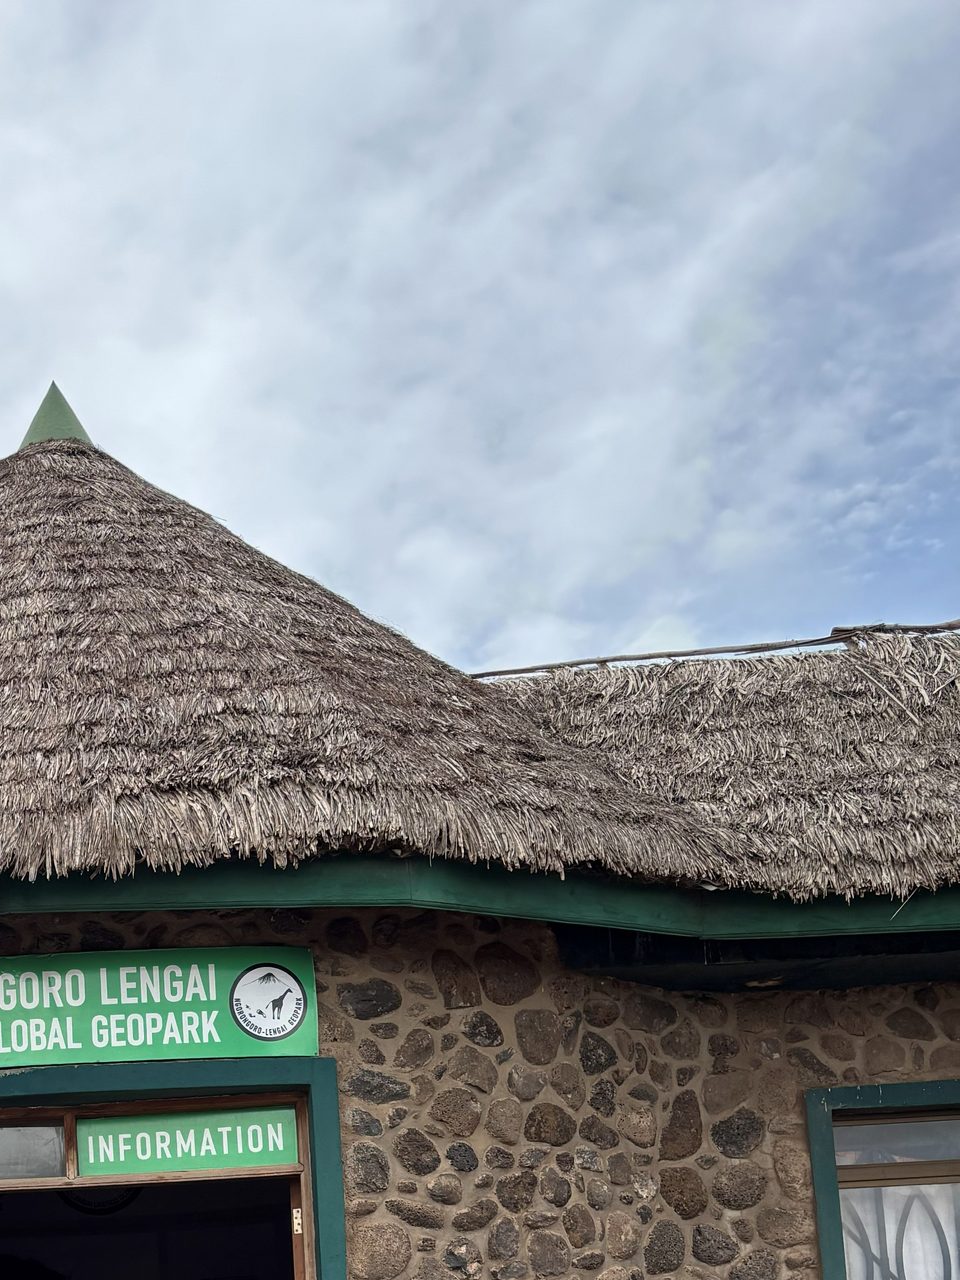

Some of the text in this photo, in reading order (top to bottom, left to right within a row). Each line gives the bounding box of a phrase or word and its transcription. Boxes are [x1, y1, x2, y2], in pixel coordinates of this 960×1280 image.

[99, 964, 217, 1005] LENGAI
[91, 1010, 221, 1048] GEOPARK
[288, 997, 302, 1025] GEOPARK
[88, 1122, 284, 1164] INFORMATION
